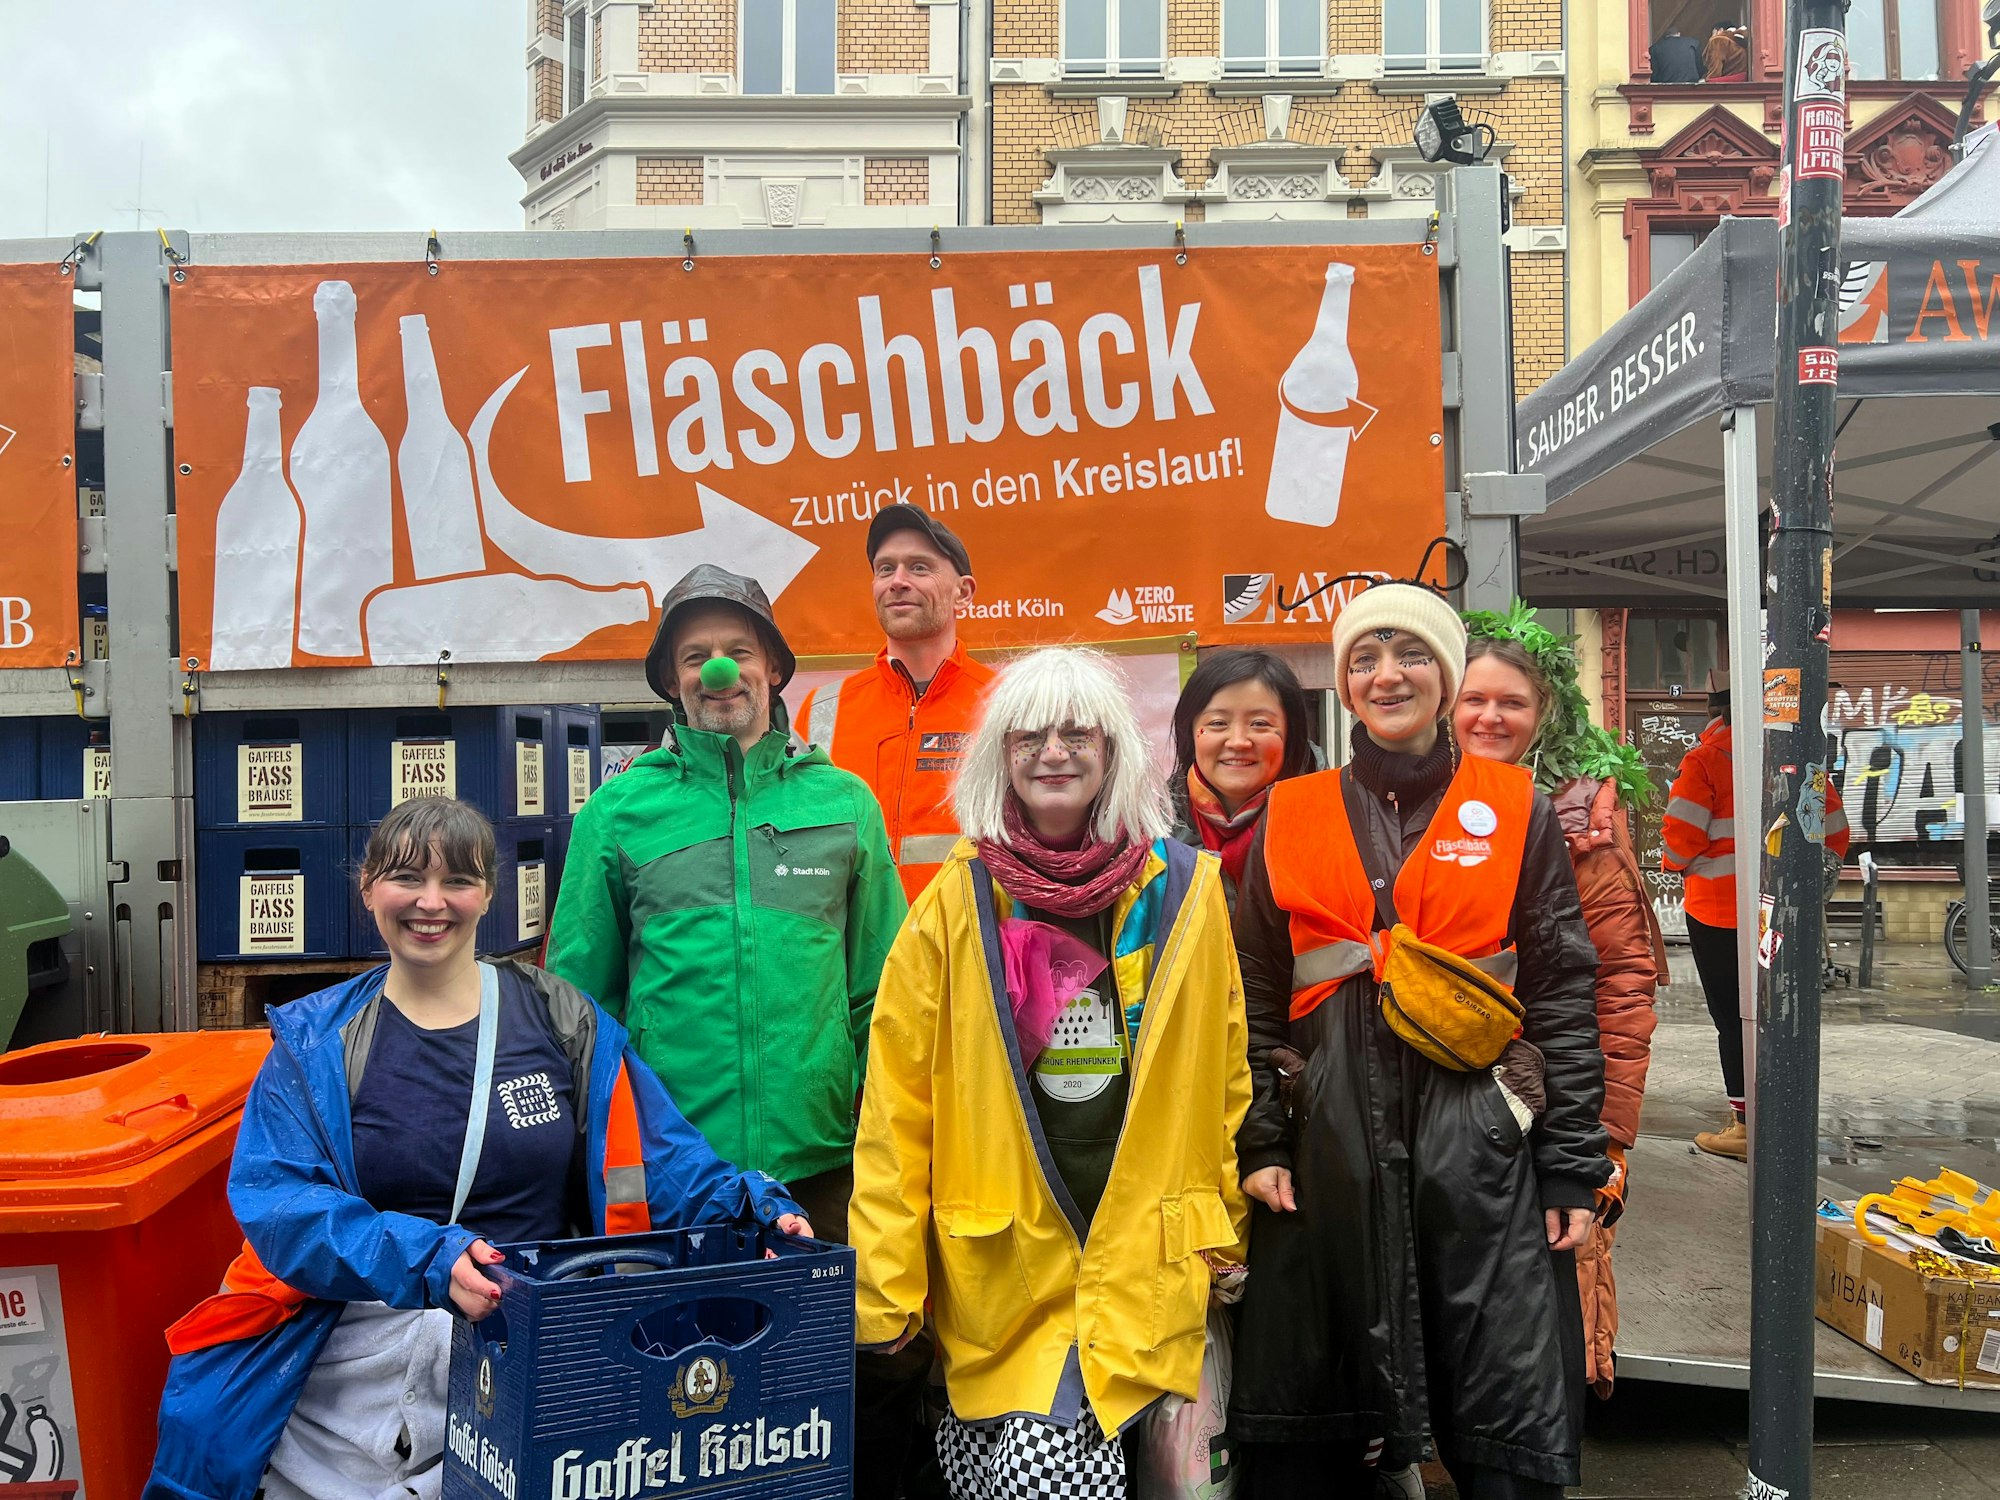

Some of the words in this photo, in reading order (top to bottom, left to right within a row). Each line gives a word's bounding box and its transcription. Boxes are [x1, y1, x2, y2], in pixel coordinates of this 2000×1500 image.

[549, 265, 1214, 483] Fläschbäck
[1528, 384, 1604, 467] SAUBER.
[1610, 311, 1705, 413] BESSER.
[925, 473, 958, 512] in
[972, 468, 1041, 508] den
[1053, 437, 1245, 498] Kreislauf!
[1134, 585, 1175, 605] ZERO
[1017, 598, 1064, 617] Köln
[1141, 604, 1195, 624] WASTE
[248, 751, 292, 763] GAFFELS
[402, 748, 445, 760] GAFFELS
[248, 765, 292, 786] FASS
[402, 763, 445, 783] FASS
[524, 764, 537, 783] FASS
[248, 789, 292, 801] BRAUSE
[402, 786, 446, 799] BRAUSE
[792, 867, 814, 875] Stadt
[814, 867, 830, 876] Köln
[250, 883, 294, 896] GAFFELS
[525, 886, 540, 906] FASS
[250, 898, 294, 919] FASS
[250, 922, 294, 935] BRAUSE
[1066, 1056, 1117, 1066] RHEINFUNKEN
[516, 1088, 541, 1099] ZERO
[1063, 1080, 1082, 1089] 2020
[519, 1094, 544, 1106] WASTE
[811, 1268, 821, 1279] 20
[829, 1265, 840, 1277] 0,5
[448, 1412, 479, 1472] Gaffel
[479, 1436, 517, 1500] Kölsch
[551, 1430, 686, 1500] Gaffel
[699, 1406, 832, 1478] Kölsch
